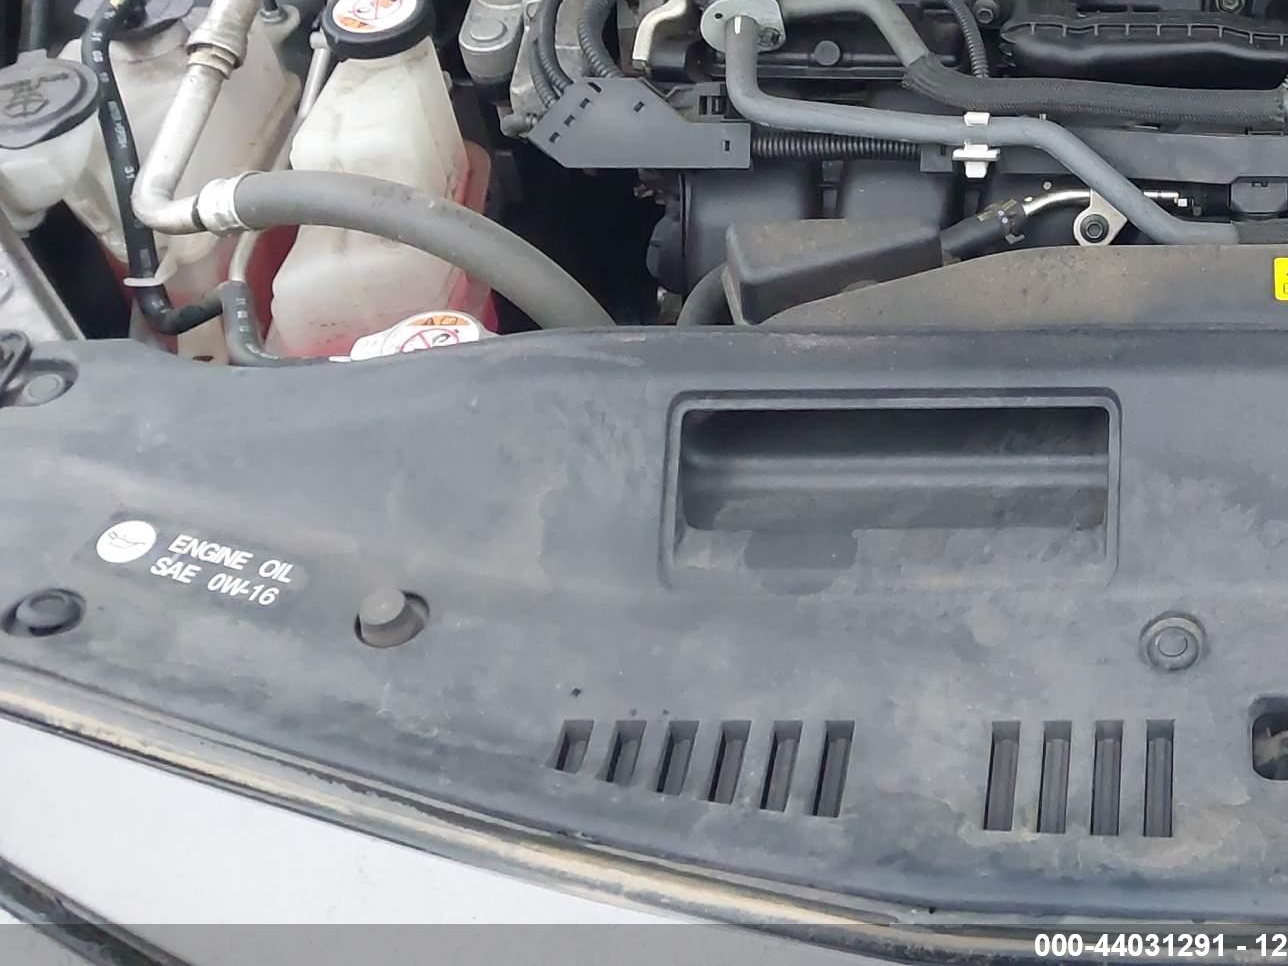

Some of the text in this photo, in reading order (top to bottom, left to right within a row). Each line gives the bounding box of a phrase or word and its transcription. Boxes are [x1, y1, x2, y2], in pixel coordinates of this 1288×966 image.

[150, 556, 280, 606] SAE 0W-16
[168, 534, 294, 583] ENGINE OIL
